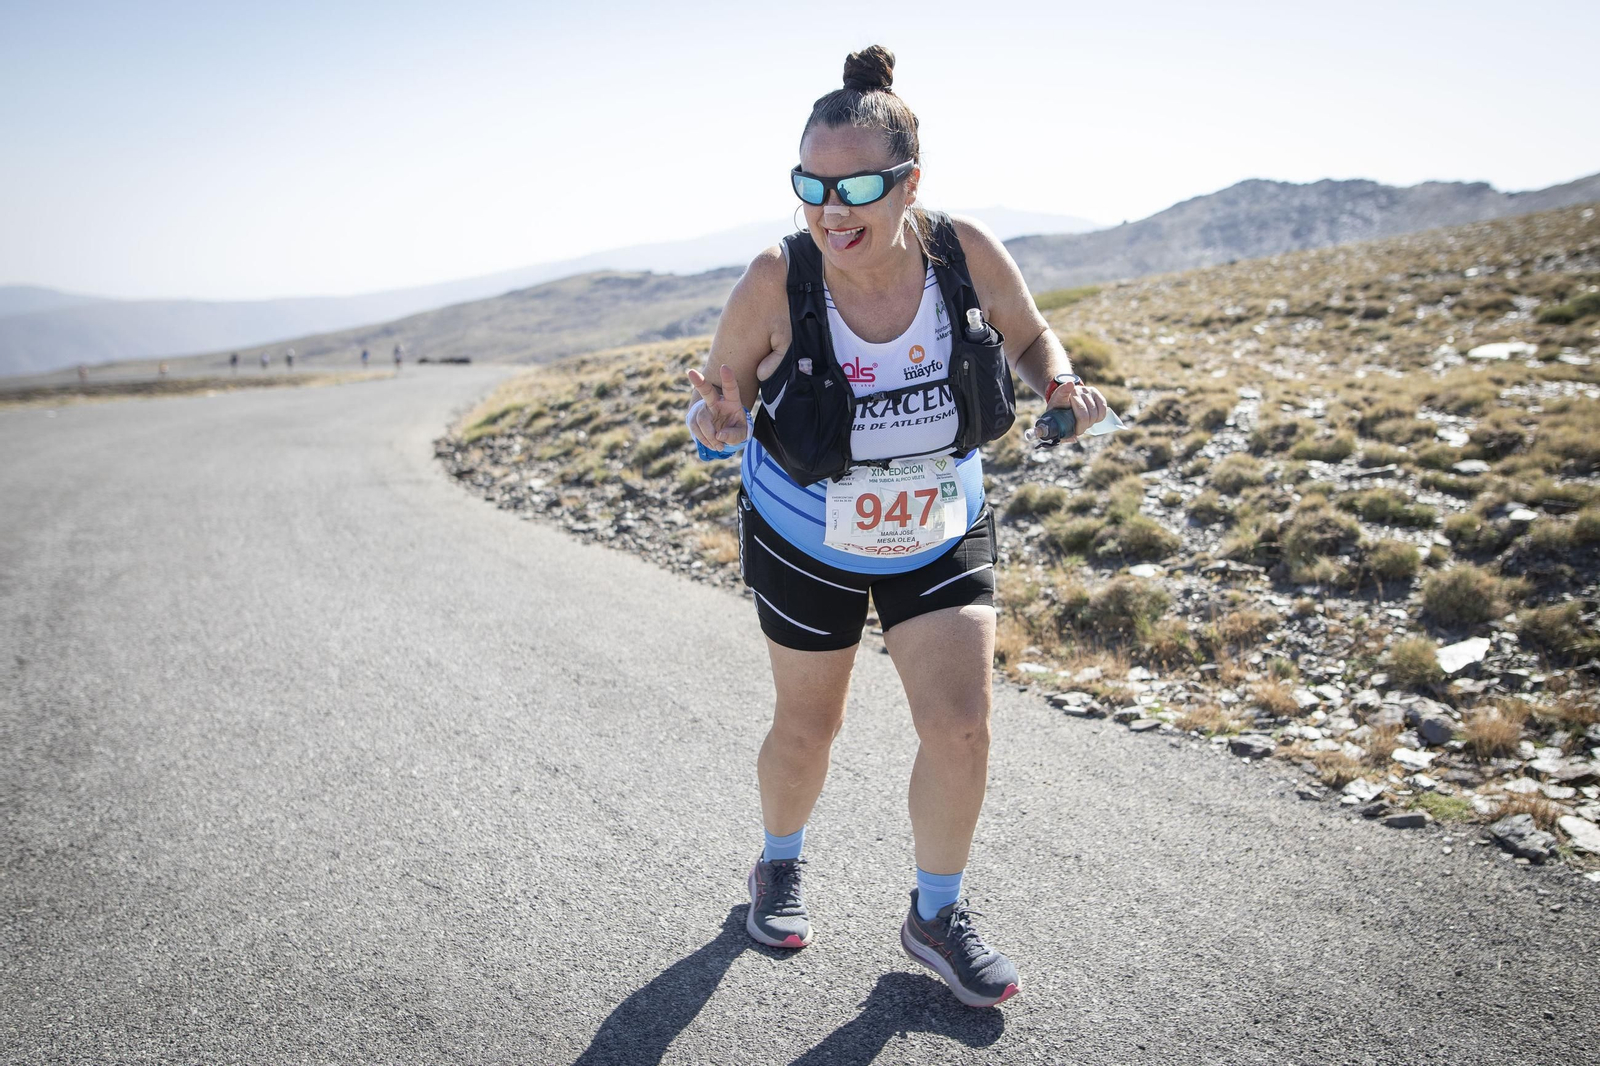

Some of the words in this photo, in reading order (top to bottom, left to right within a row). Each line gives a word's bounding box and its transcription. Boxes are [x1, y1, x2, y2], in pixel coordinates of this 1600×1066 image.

[903, 363, 922, 373] grupo
[904, 360, 943, 380] mayfo
[853, 386, 954, 419] RACEN
[870, 422, 887, 431] DE
[890, 406, 957, 429] ATLETISMO
[871, 468, 886, 477] XIX
[856, 487, 939, 531] 947
